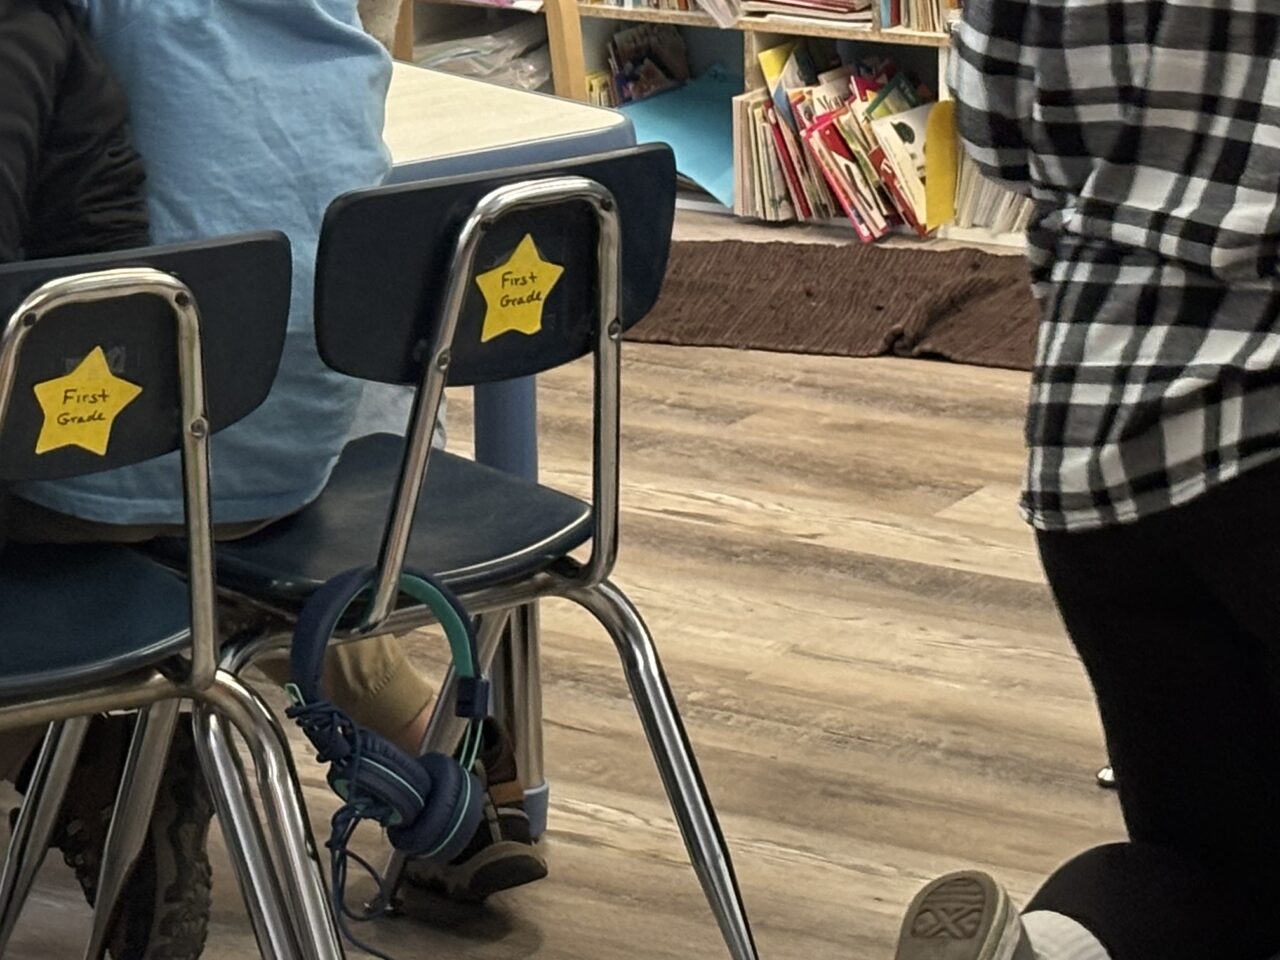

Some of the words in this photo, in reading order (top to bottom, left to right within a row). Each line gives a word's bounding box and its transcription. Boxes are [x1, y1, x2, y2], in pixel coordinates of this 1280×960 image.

[501, 270, 538, 289] First
[500, 290, 542, 308] Grade
[62, 388, 110, 405] First
[56, 409, 106, 426] Grade
